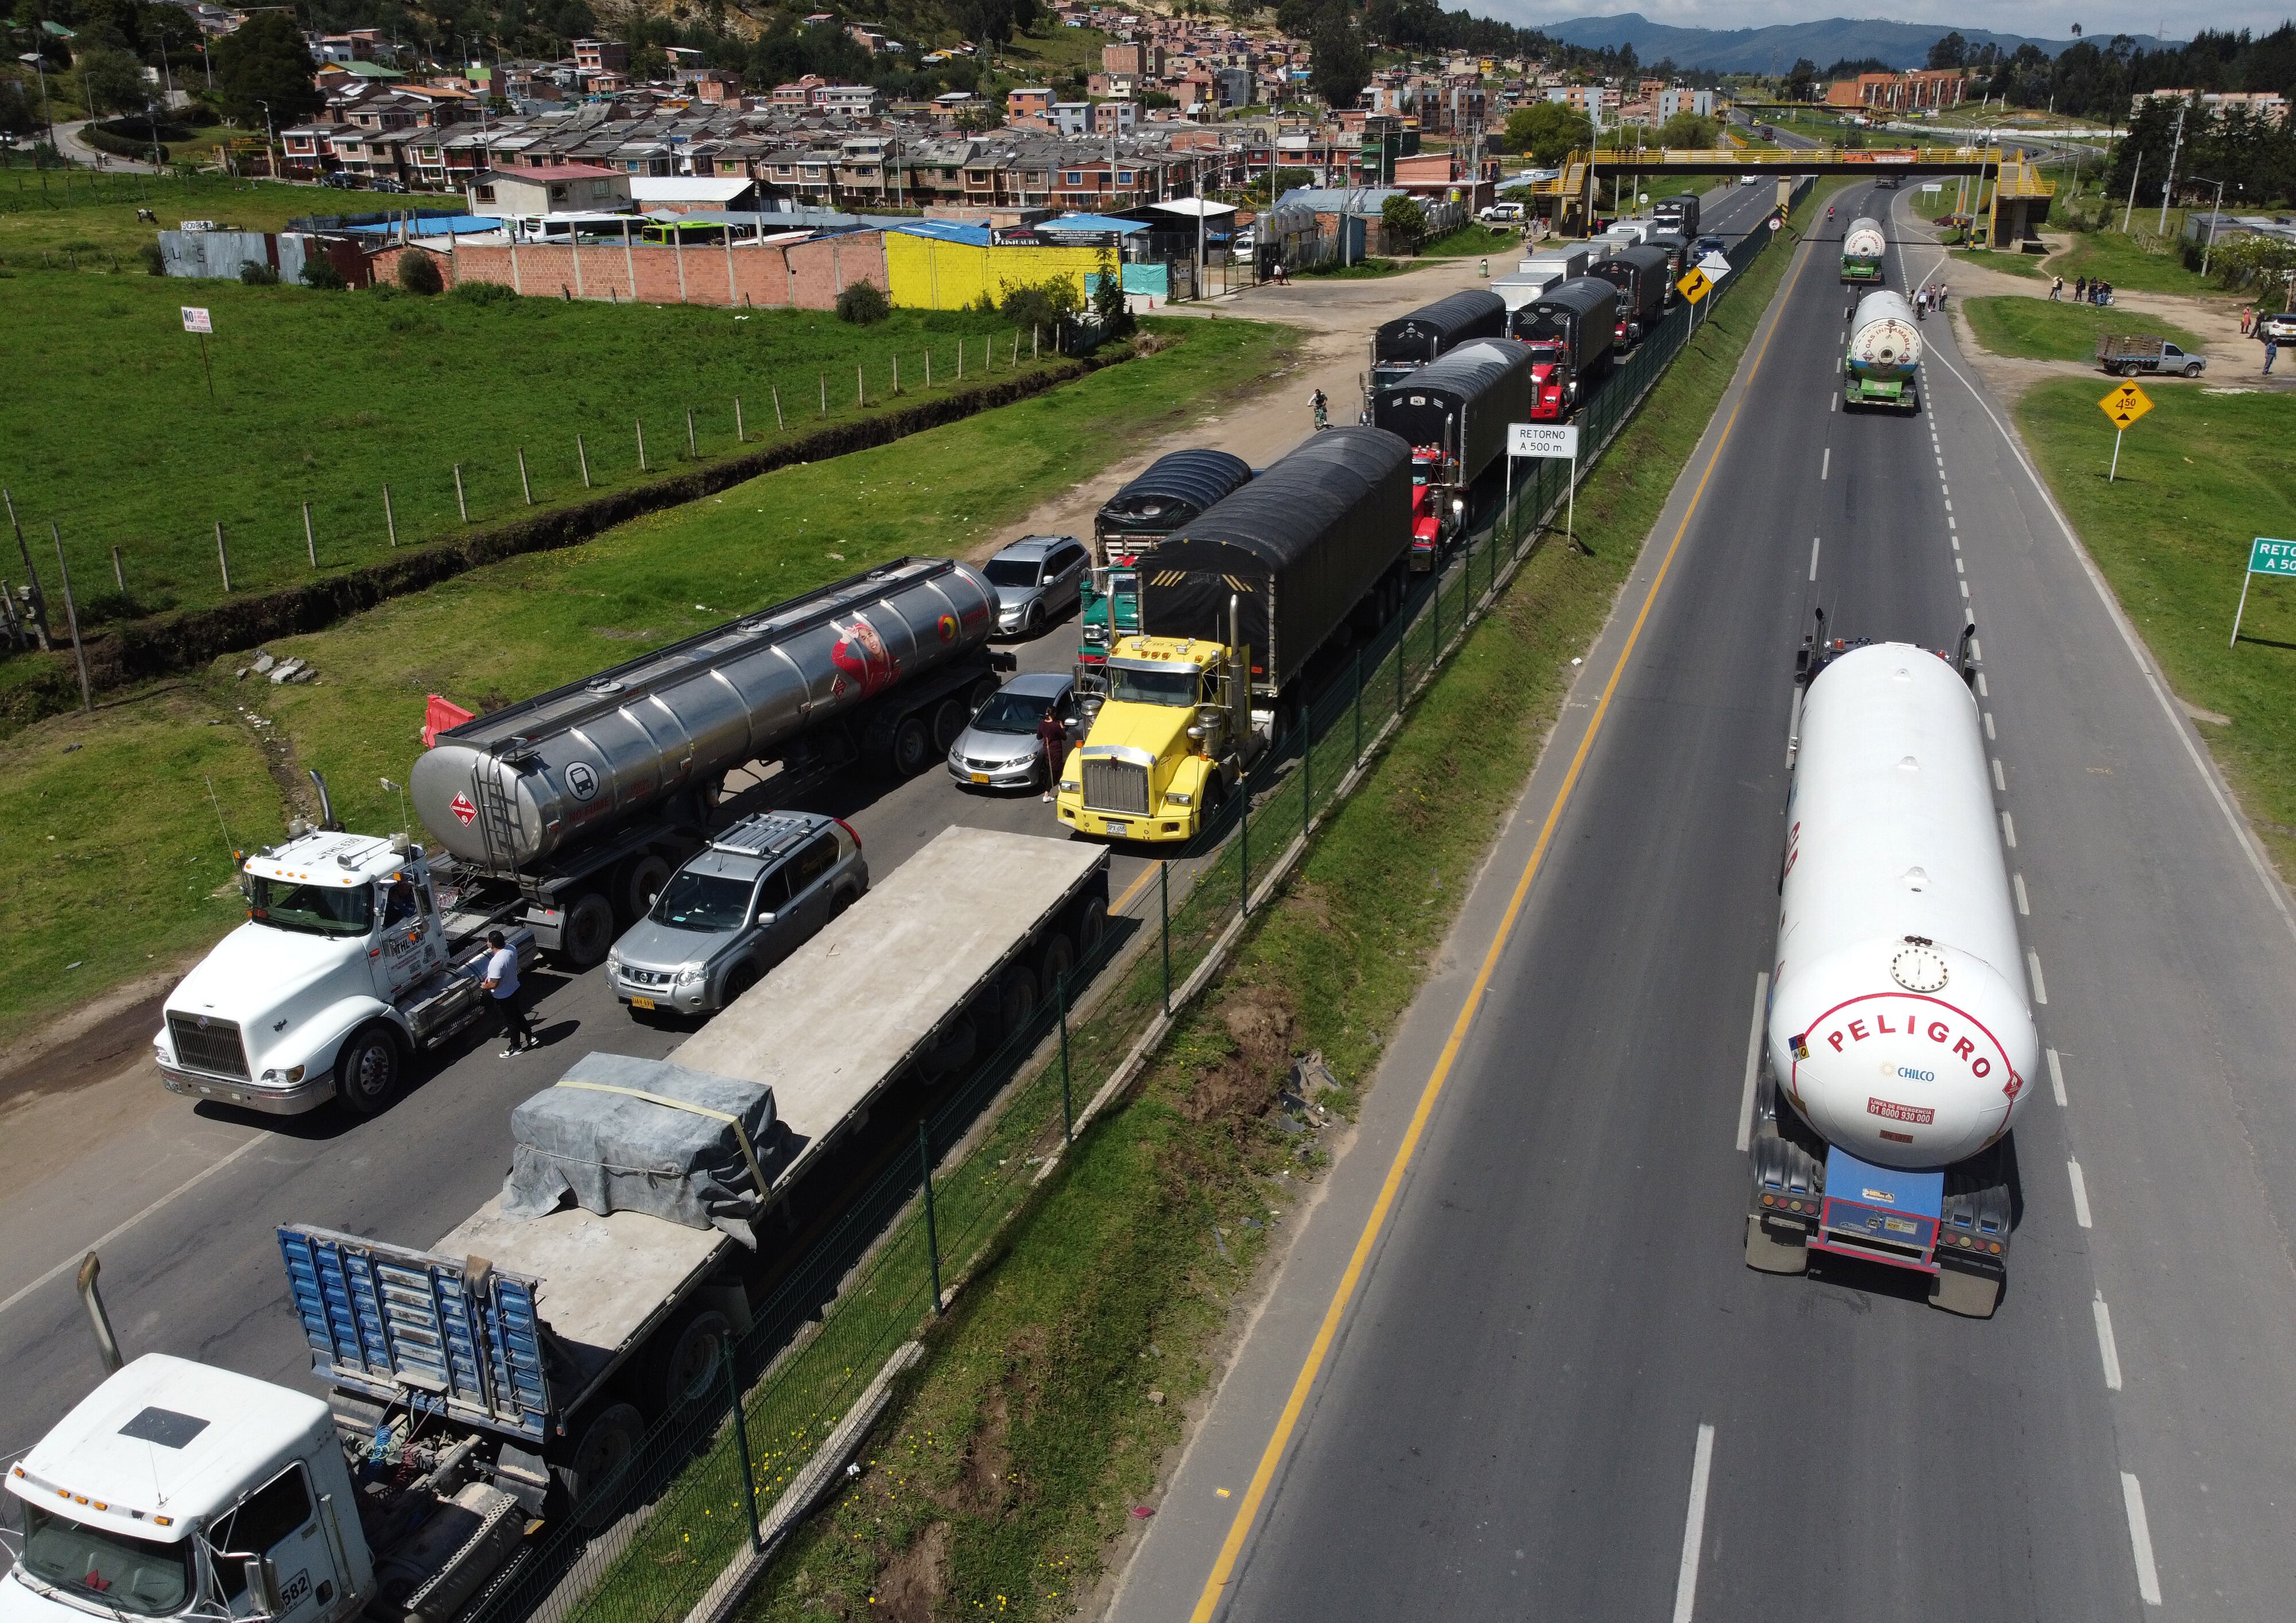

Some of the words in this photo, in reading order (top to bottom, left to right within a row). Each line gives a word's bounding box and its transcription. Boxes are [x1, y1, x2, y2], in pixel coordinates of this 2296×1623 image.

[183, 309, 194, 323] NO
[1520, 429, 1565, 440] RETORNO
[1520, 442, 1527, 451] A
[1530, 442, 1550, 451] 500
[2265, 558, 2275, 568] A
[1828, 1014, 1991, 1078] PELIGRO
[1898, 1067, 1935, 1082] CHILCO
[1870, 1105, 1879, 1114] 01
[1881, 1107, 1899, 1118] 8000
[1901, 1111, 1915, 1121] 930
[1917, 1114, 1931, 1123] 000
[1871, 1099, 1887, 1108] LINEA
[1896, 1105, 1932, 1115] EMERGENCIA
